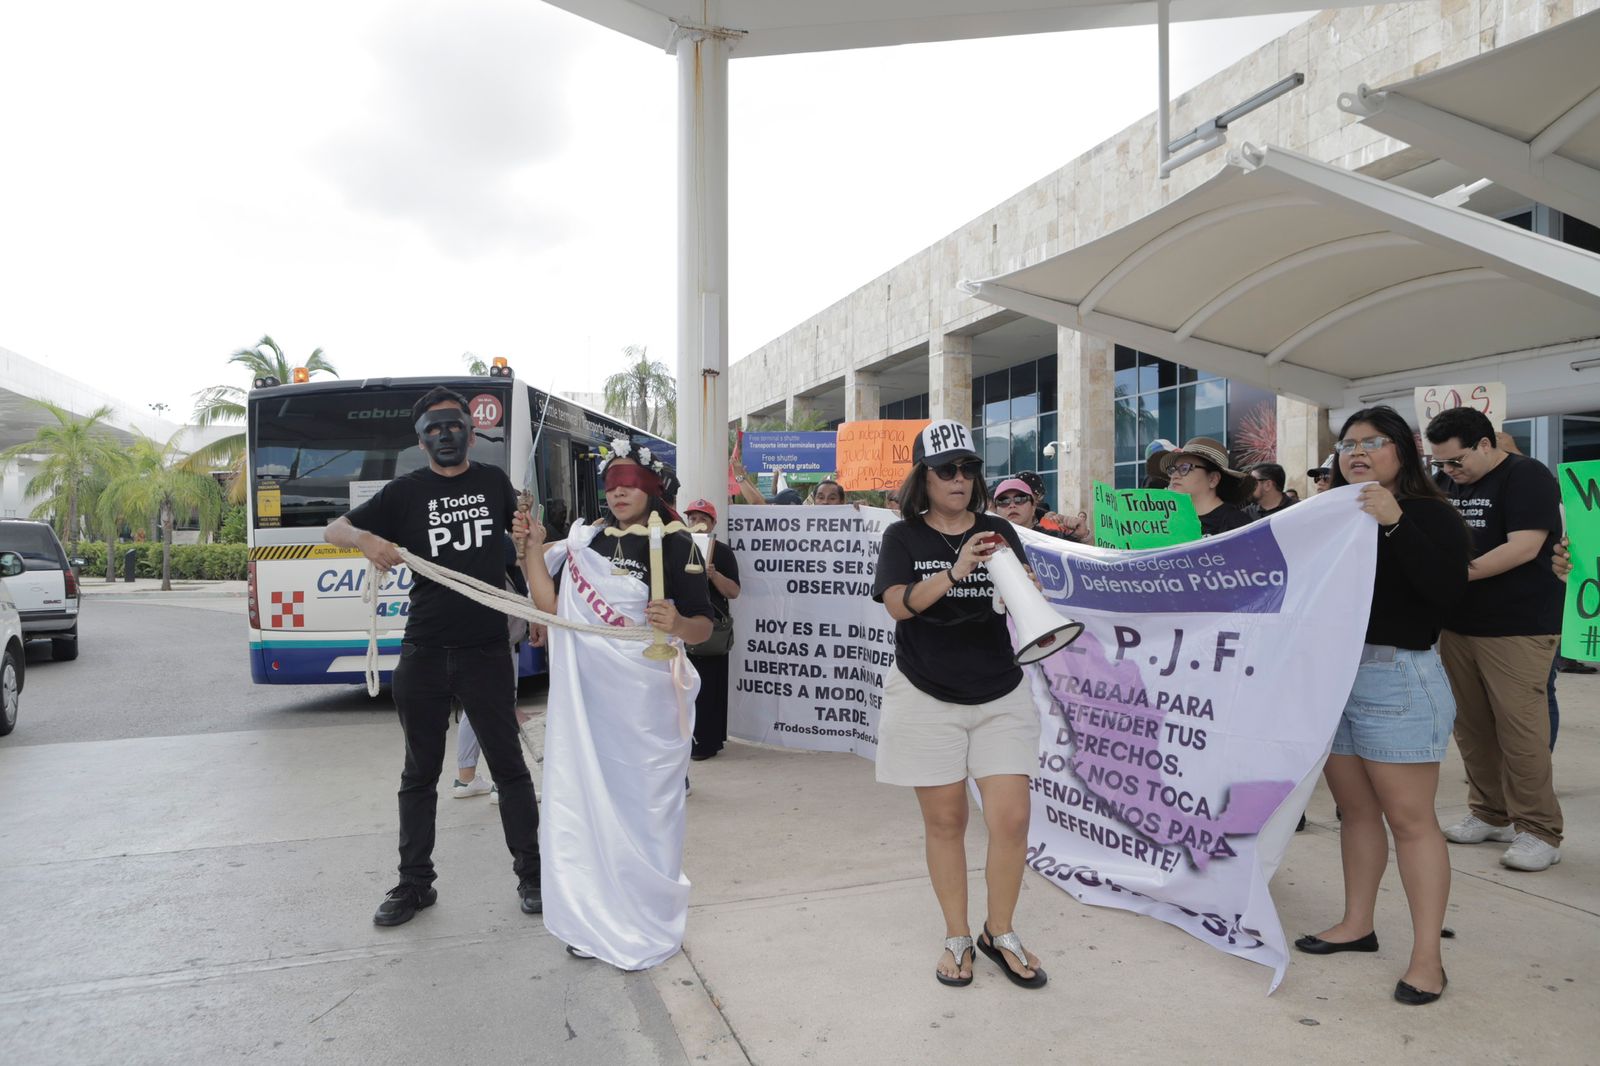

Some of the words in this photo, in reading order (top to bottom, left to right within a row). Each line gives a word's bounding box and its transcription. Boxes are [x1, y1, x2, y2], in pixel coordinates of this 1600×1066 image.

[473, 403, 496, 420] 40
[930, 424, 966, 453] #PJF
[762, 454, 775, 462] Free
[777, 454, 798, 462] shuttle
[893, 444, 909, 462] NO
[762, 462, 794, 470] Transporte
[796, 462, 820, 470] gratuito
[440, 494, 485, 509] Todos
[1121, 493, 1177, 519] Trabaja
[428, 506, 489, 526] Somos
[728, 518, 800, 532] ESTAMOS
[427, 518, 493, 557] PJF
[1120, 520, 1169, 536] NOCHE
[339, 547, 351, 555] WIDE
[751, 539, 865, 556] DEMOCRACIA,
[754, 559, 826, 573] QUIERES
[832, 560, 863, 574] SER
[914, 560, 952, 570] JUECES
[1128, 555, 1194, 572] Federal
[1198, 553, 1226, 567] de
[1081, 569, 1184, 593] Defensoría
[1187, 568, 1285, 592] Pública
[755, 619, 787, 634] HOY
[792, 621, 813, 636] ES
[819, 623, 841, 637] EL
[868, 627, 884, 643] DE
[747, 639, 809, 657] SALGAS
[814, 644, 827, 658] A
[744, 659, 827, 679] LIBERTAD.
[833, 665, 883, 689] MAÑANA
[736, 678, 792, 697] JUECES
[797, 685, 809, 699] A
[815, 686, 867, 707] MODO,
[1053, 672, 1149, 708] TRABAJA
[1156, 690, 1214, 721] PARA
[814, 706, 870, 727] TARDE.
[1049, 700, 1158, 740] DEFENDER
[1165, 722, 1207, 751] TUS
[1056, 727, 1183, 777] DERECHOS.
[1087, 765, 1139, 796] NOS
[1146, 780, 1212, 820] TOCA
[1046, 804, 1181, 873] DEFENDERTE!
[1167, 819, 1238, 857] PARA
